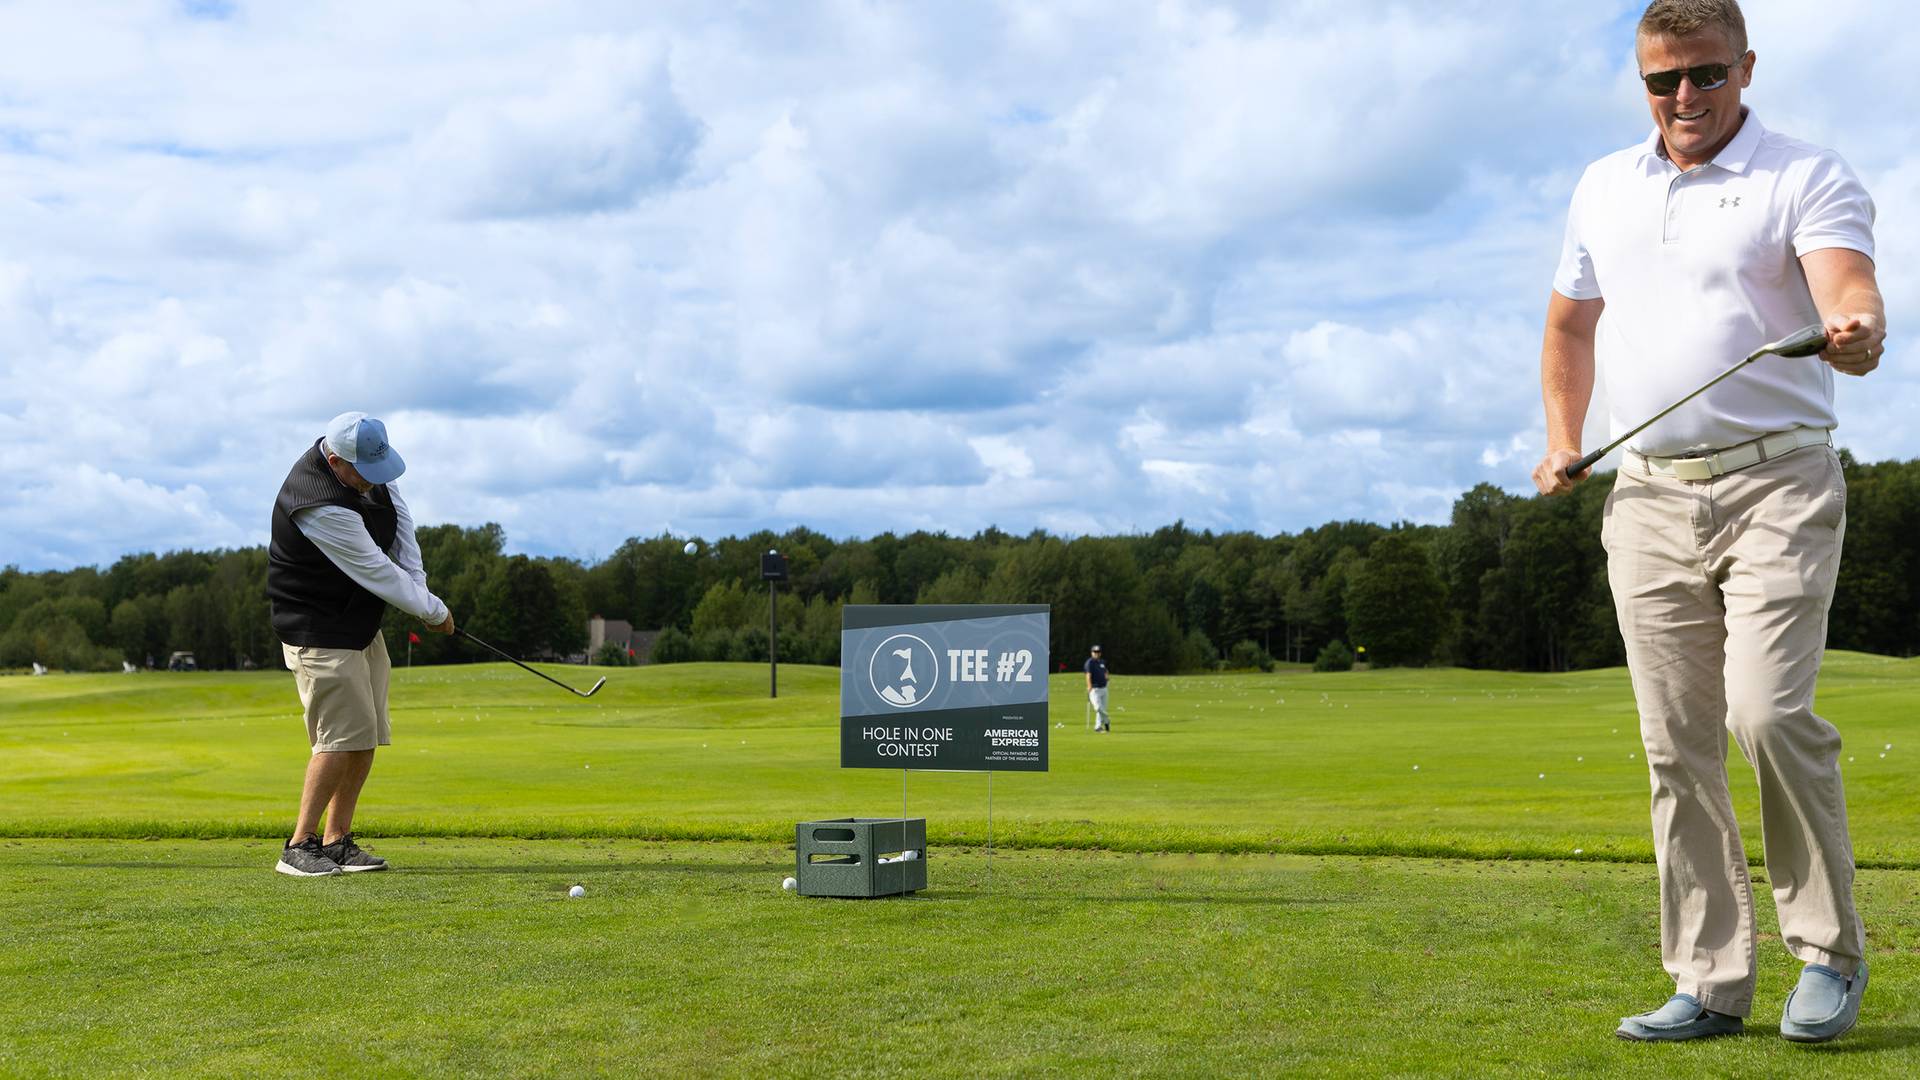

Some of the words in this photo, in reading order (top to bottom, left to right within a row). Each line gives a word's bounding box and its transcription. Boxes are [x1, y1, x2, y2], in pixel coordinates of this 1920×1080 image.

[947, 649, 989, 682] TEE
[996, 649, 1033, 682] #2
[863, 727, 901, 740] HOLE
[904, 727, 919, 741] IN
[922, 727, 953, 741] ONE
[984, 729, 1038, 738] AMERICAN
[991, 738, 1039, 747] EXPRESS
[877, 743, 940, 757] CONTEST
